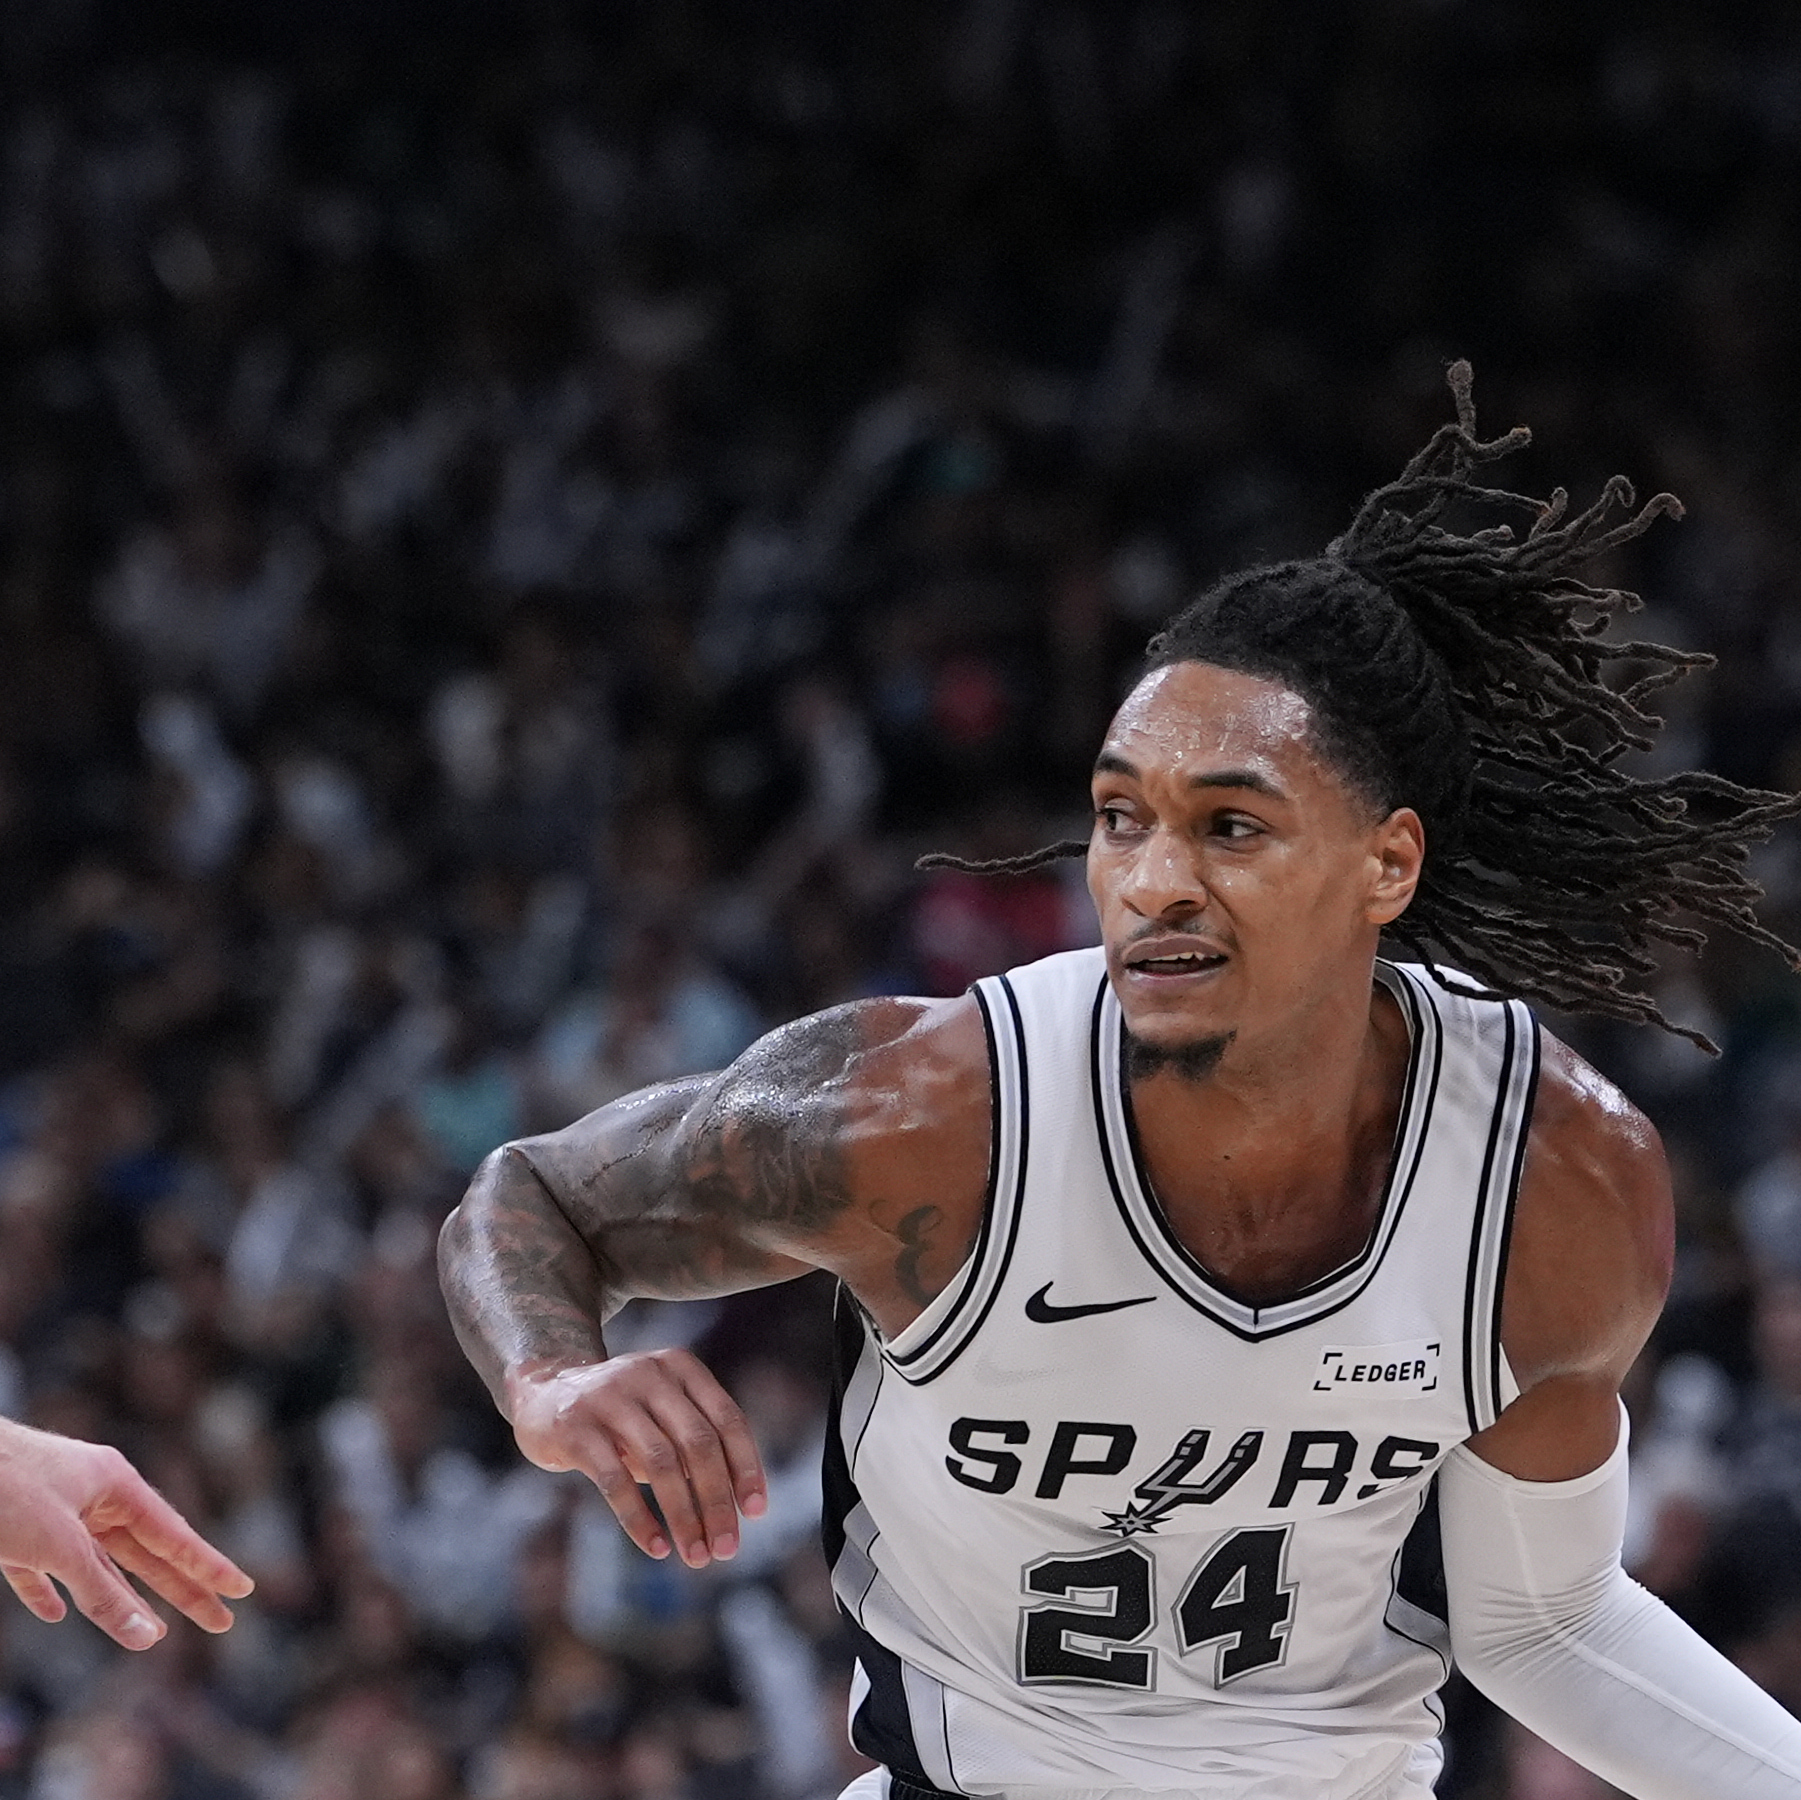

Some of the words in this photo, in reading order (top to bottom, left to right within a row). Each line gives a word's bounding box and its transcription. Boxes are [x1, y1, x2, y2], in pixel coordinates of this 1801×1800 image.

[1334, 1359, 1426, 1382] LEDGER
[944, 1417, 1441, 1536] SPURS
[1016, 1522, 1300, 1692] 24
